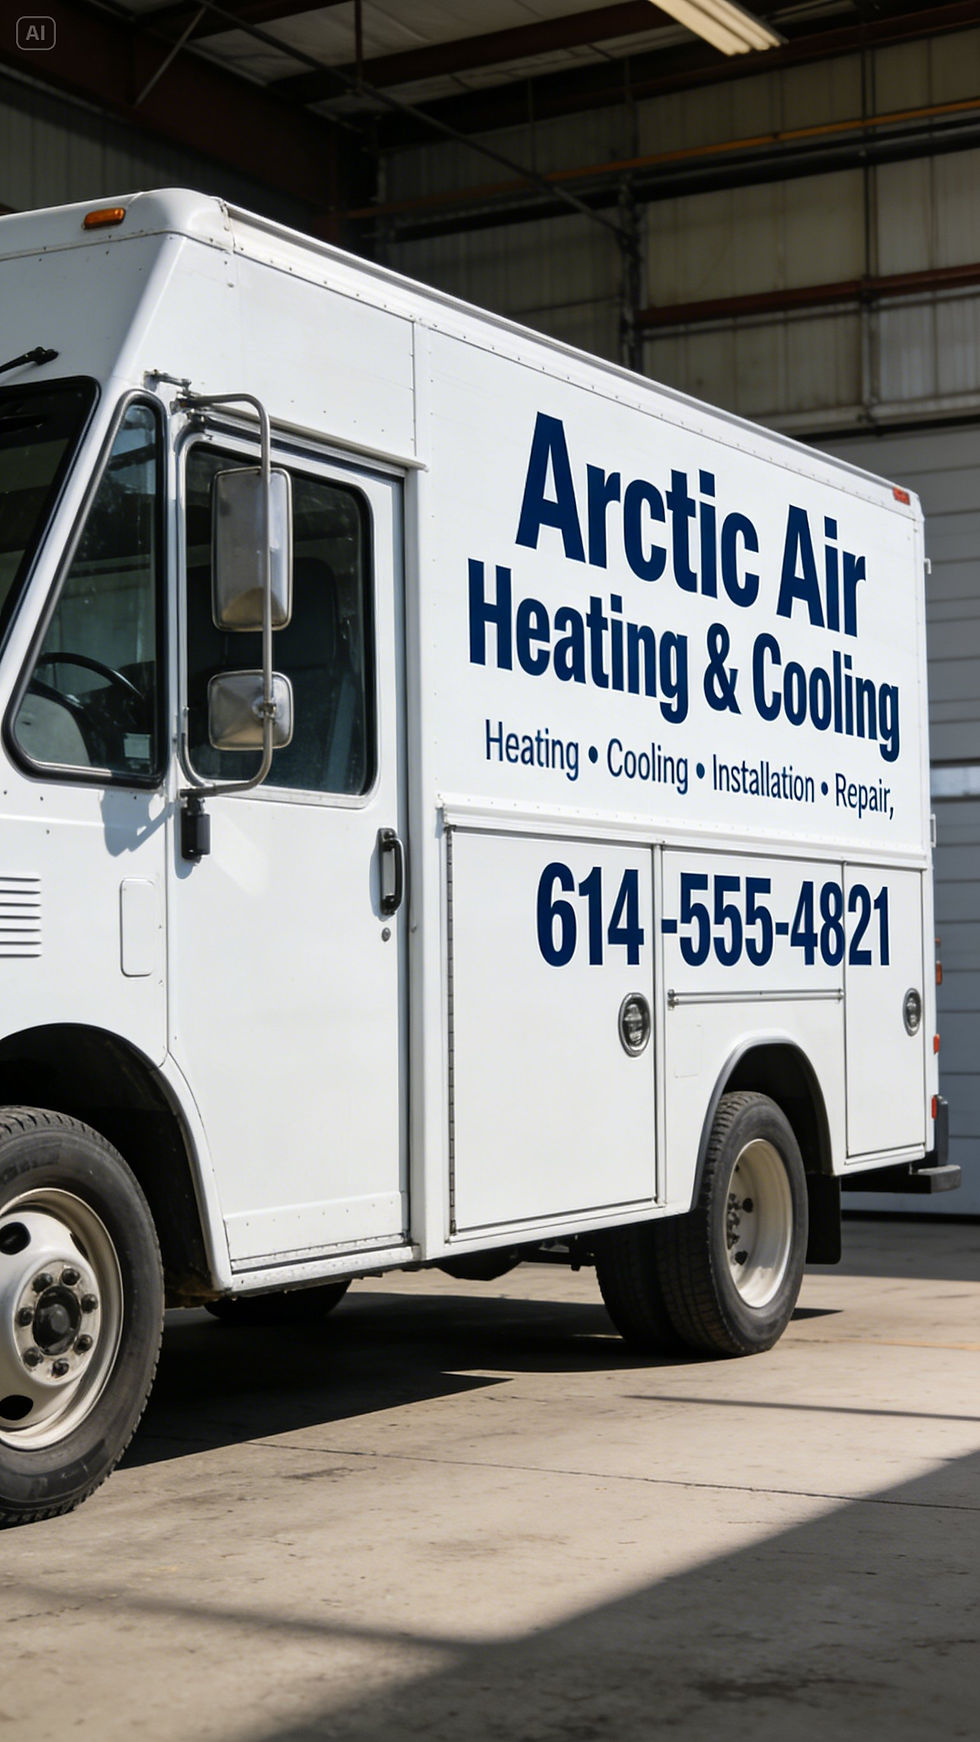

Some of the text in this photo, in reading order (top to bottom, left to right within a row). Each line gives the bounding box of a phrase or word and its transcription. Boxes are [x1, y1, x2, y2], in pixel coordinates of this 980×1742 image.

[515, 412, 867, 638] Arctic Air
[467, 558, 900, 763] Heating & Cooling
[484, 719, 895, 820] Heating Cooling Installation Repair,
